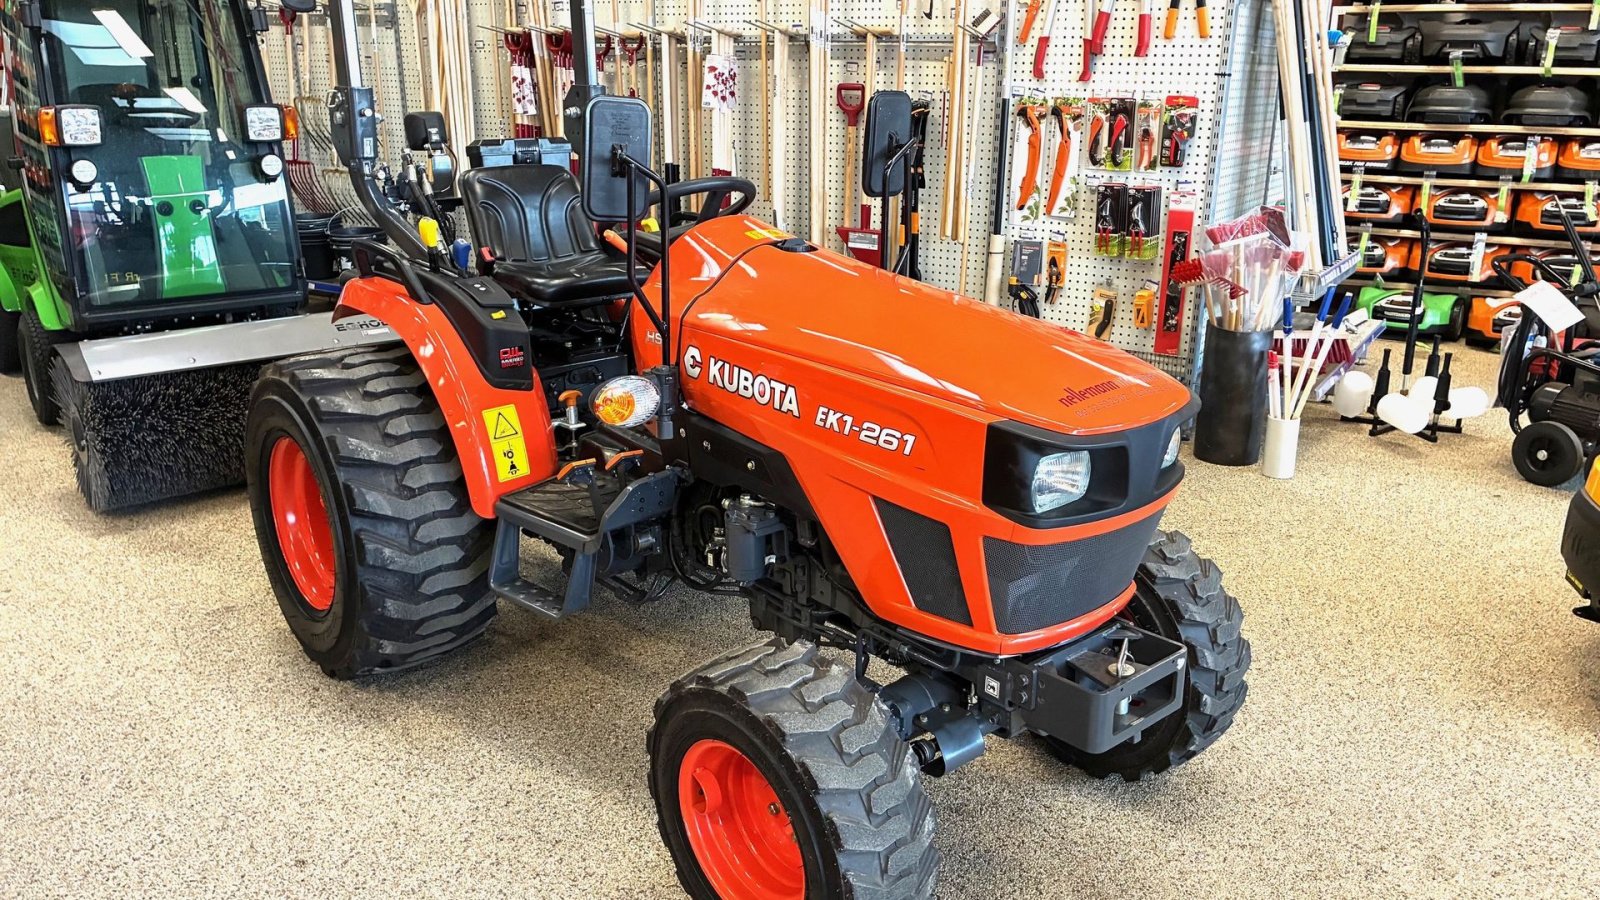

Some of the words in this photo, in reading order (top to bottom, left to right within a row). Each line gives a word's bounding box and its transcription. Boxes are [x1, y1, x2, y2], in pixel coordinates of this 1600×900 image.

[708, 356, 800, 418] KUBOTA
[1058, 380, 1121, 408] nellemann
[814, 405, 917, 456] EK1-261
